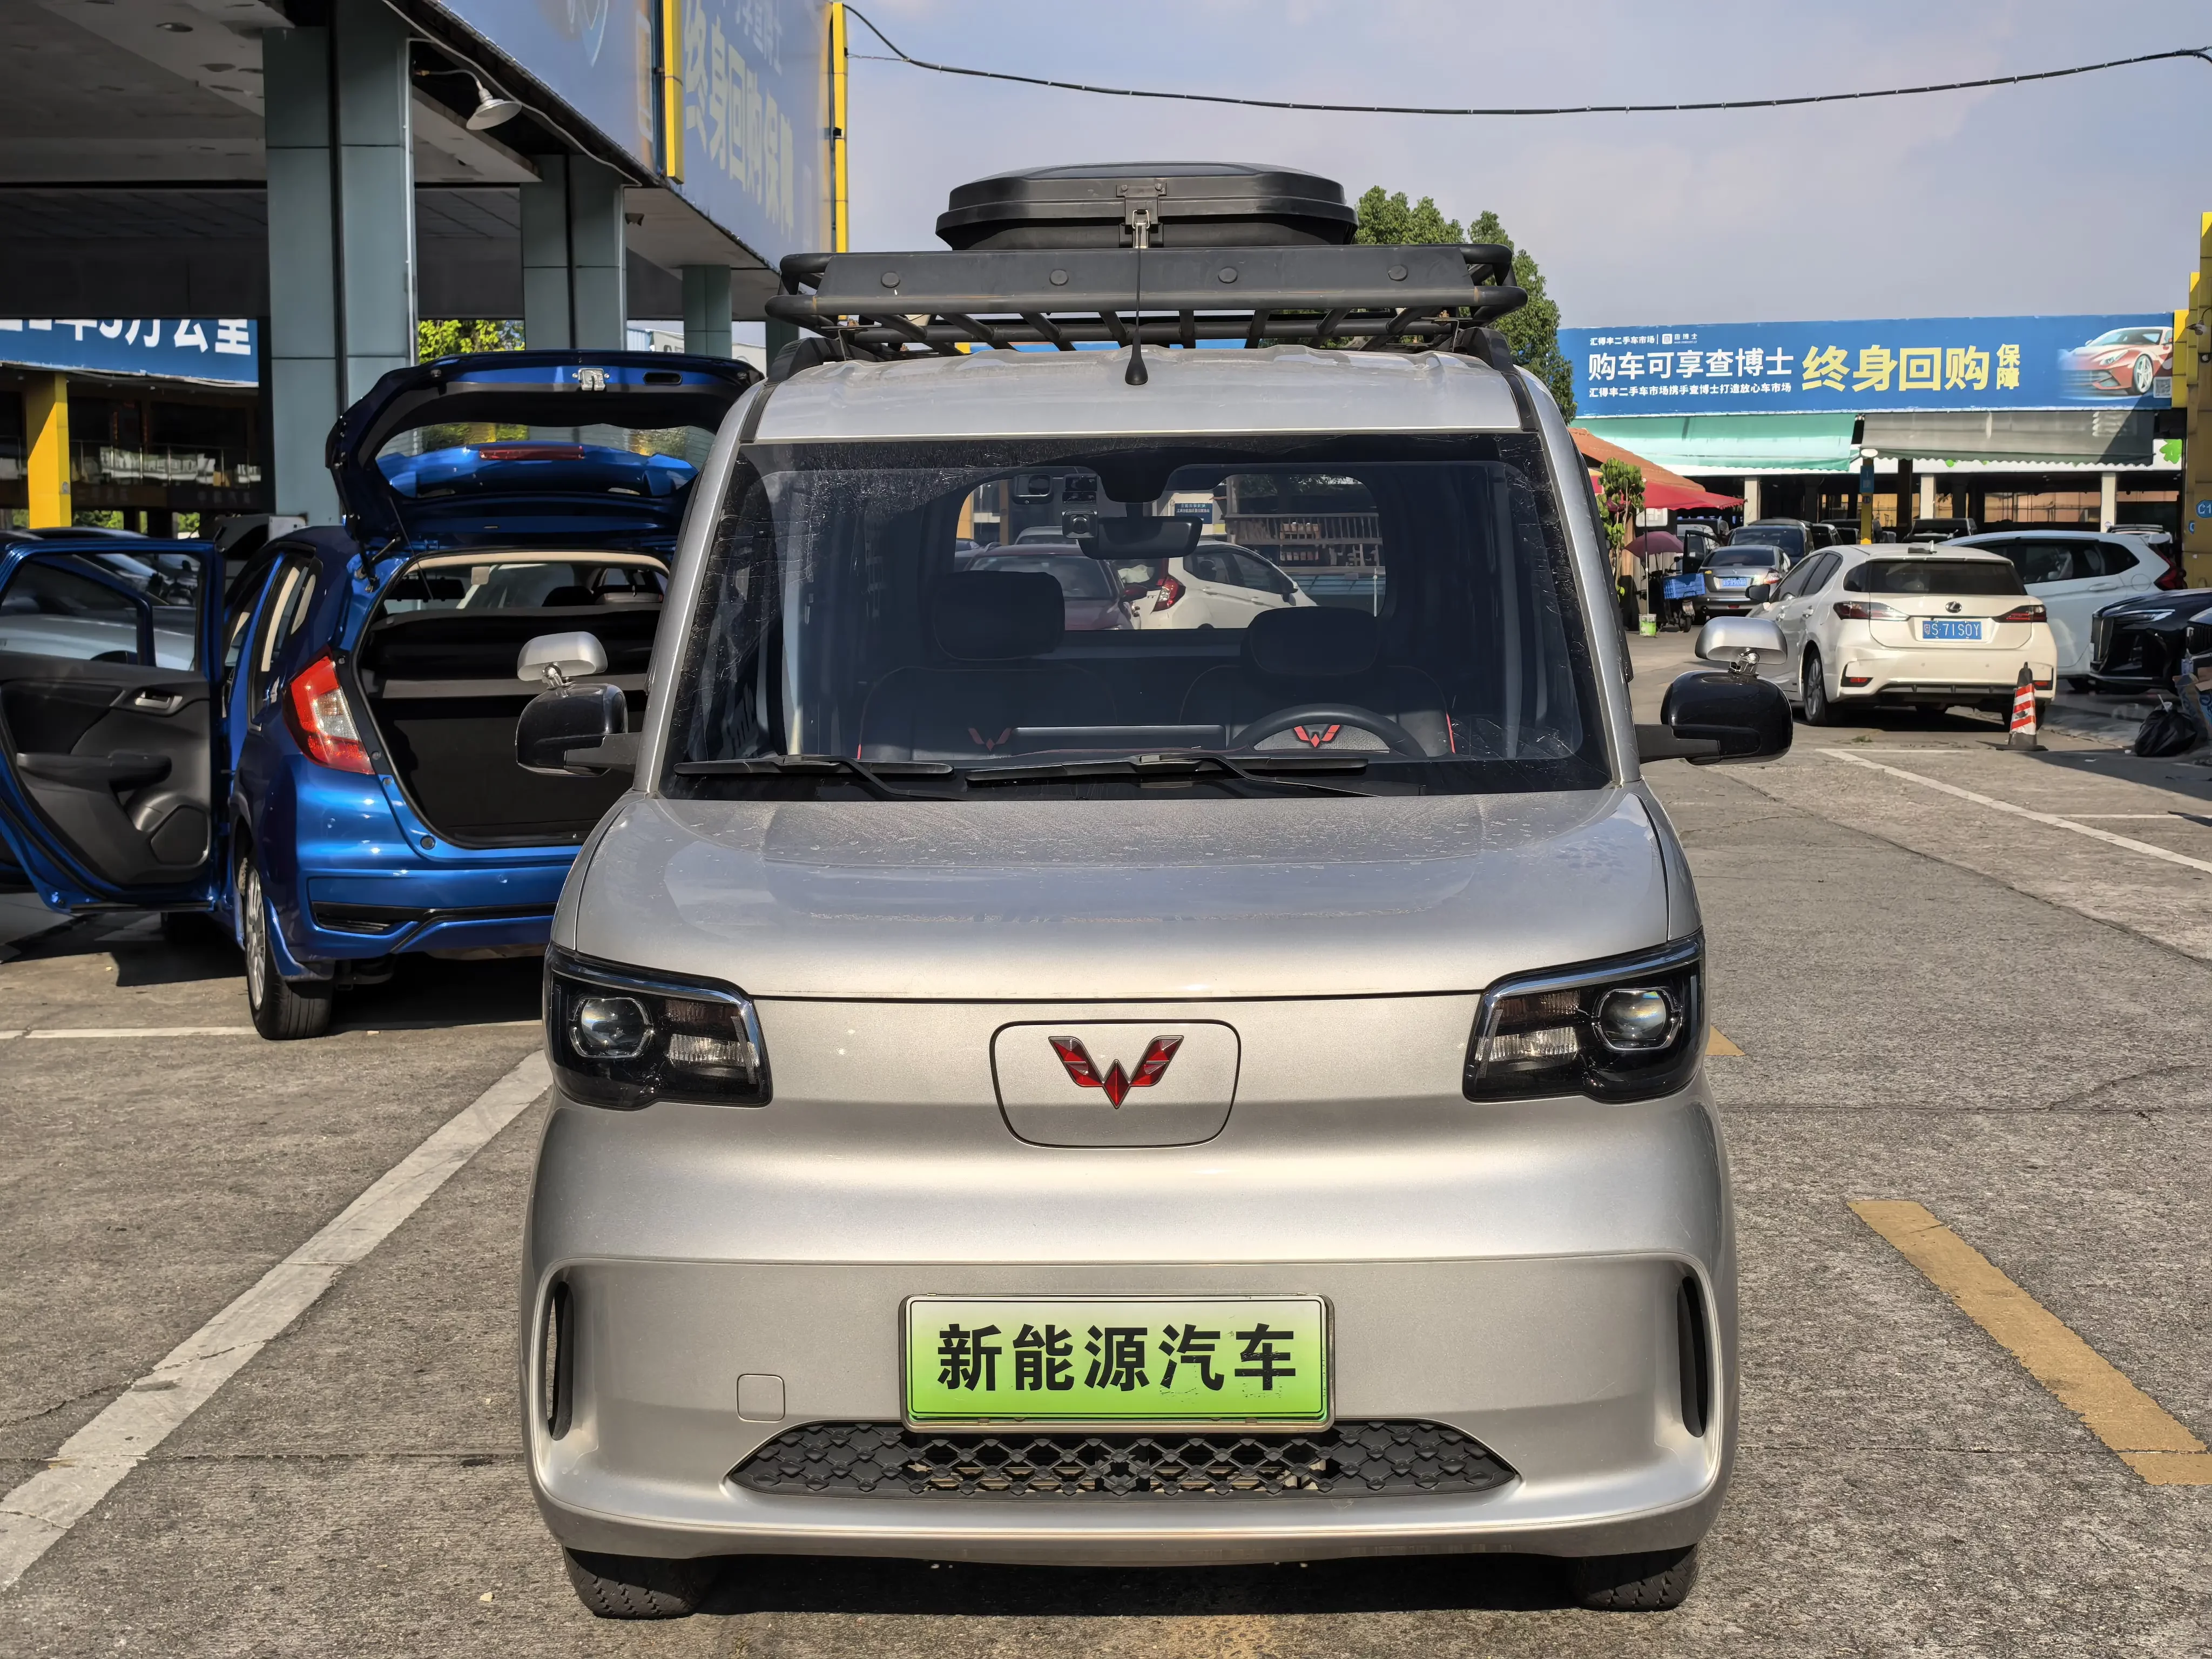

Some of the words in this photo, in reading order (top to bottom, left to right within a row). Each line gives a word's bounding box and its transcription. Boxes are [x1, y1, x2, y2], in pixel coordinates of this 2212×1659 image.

[1588, 347, 1794, 381] 购车可享查博士
[938, 1323, 1296, 1392] 新能源汽车
